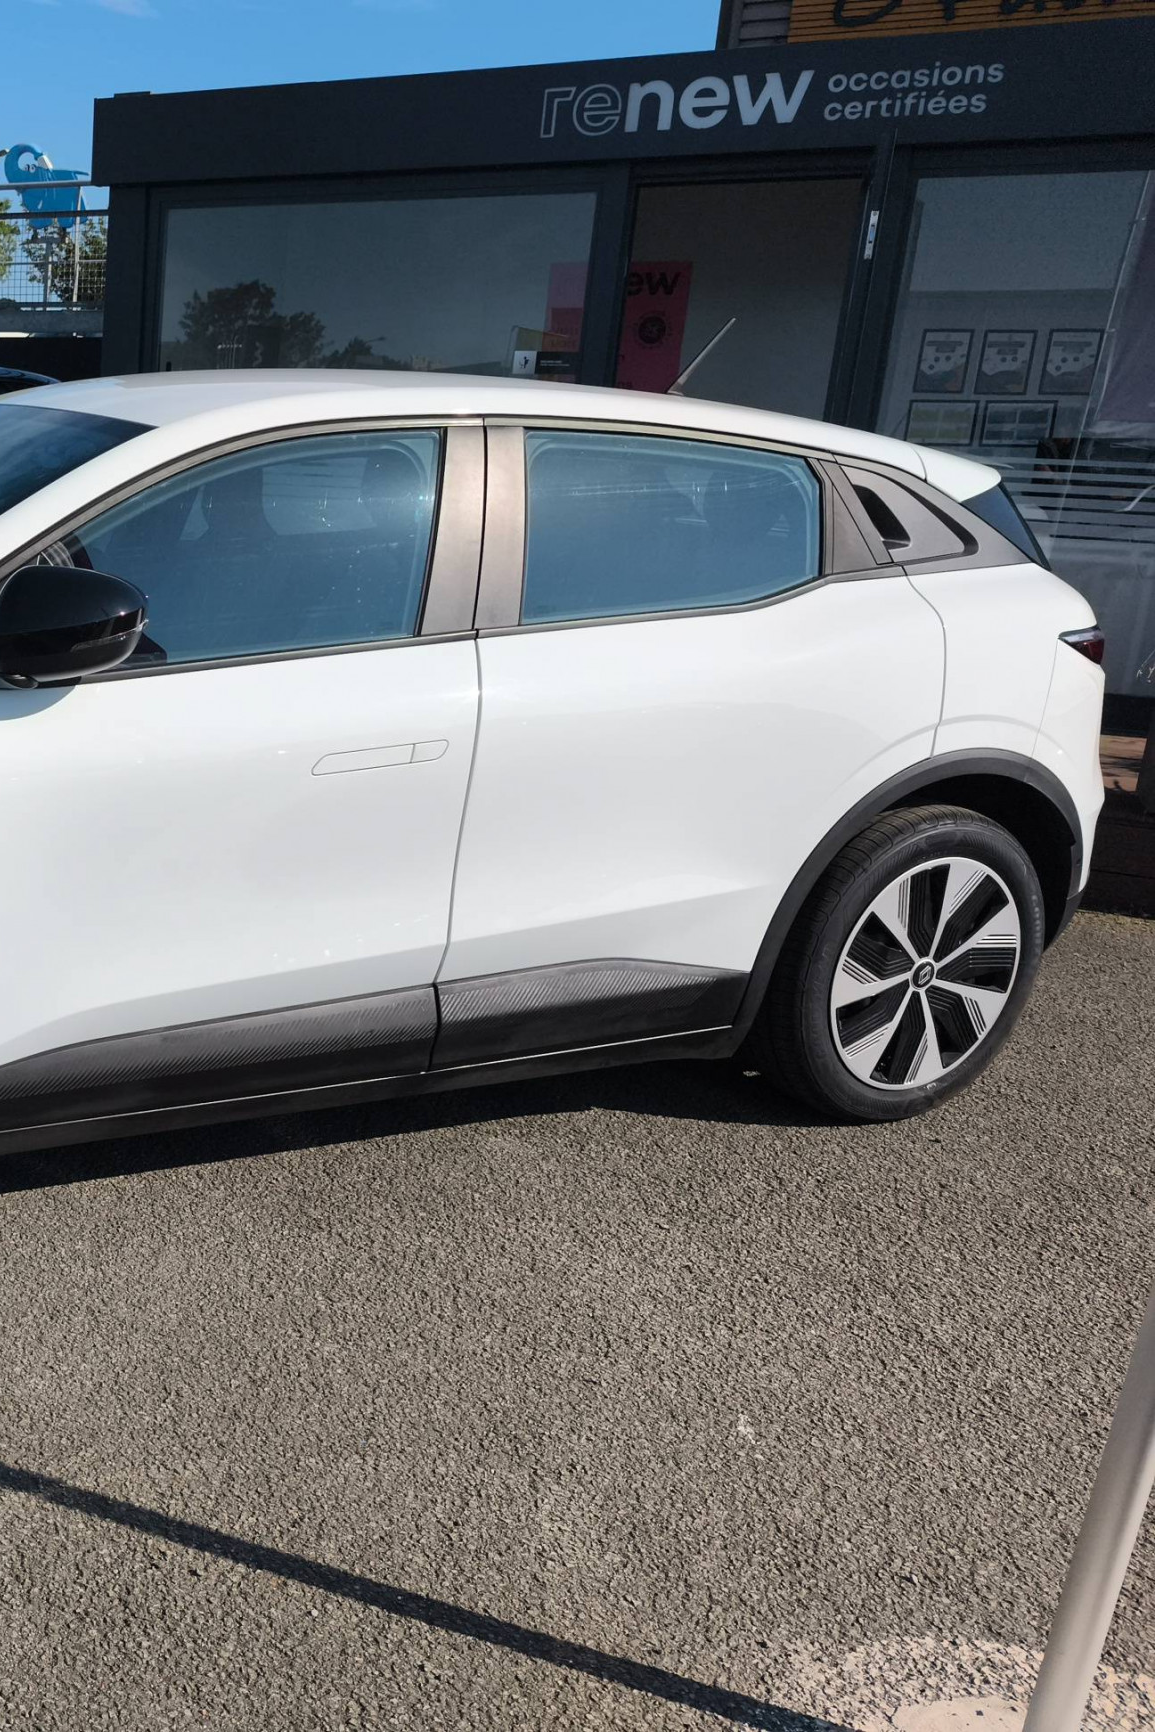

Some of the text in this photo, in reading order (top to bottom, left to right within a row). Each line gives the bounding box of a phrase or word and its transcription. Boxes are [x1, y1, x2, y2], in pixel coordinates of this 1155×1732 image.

[828, 61, 1006, 93] occasions
[540, 70, 815, 138] renew
[823, 90, 988, 122] certifiées
